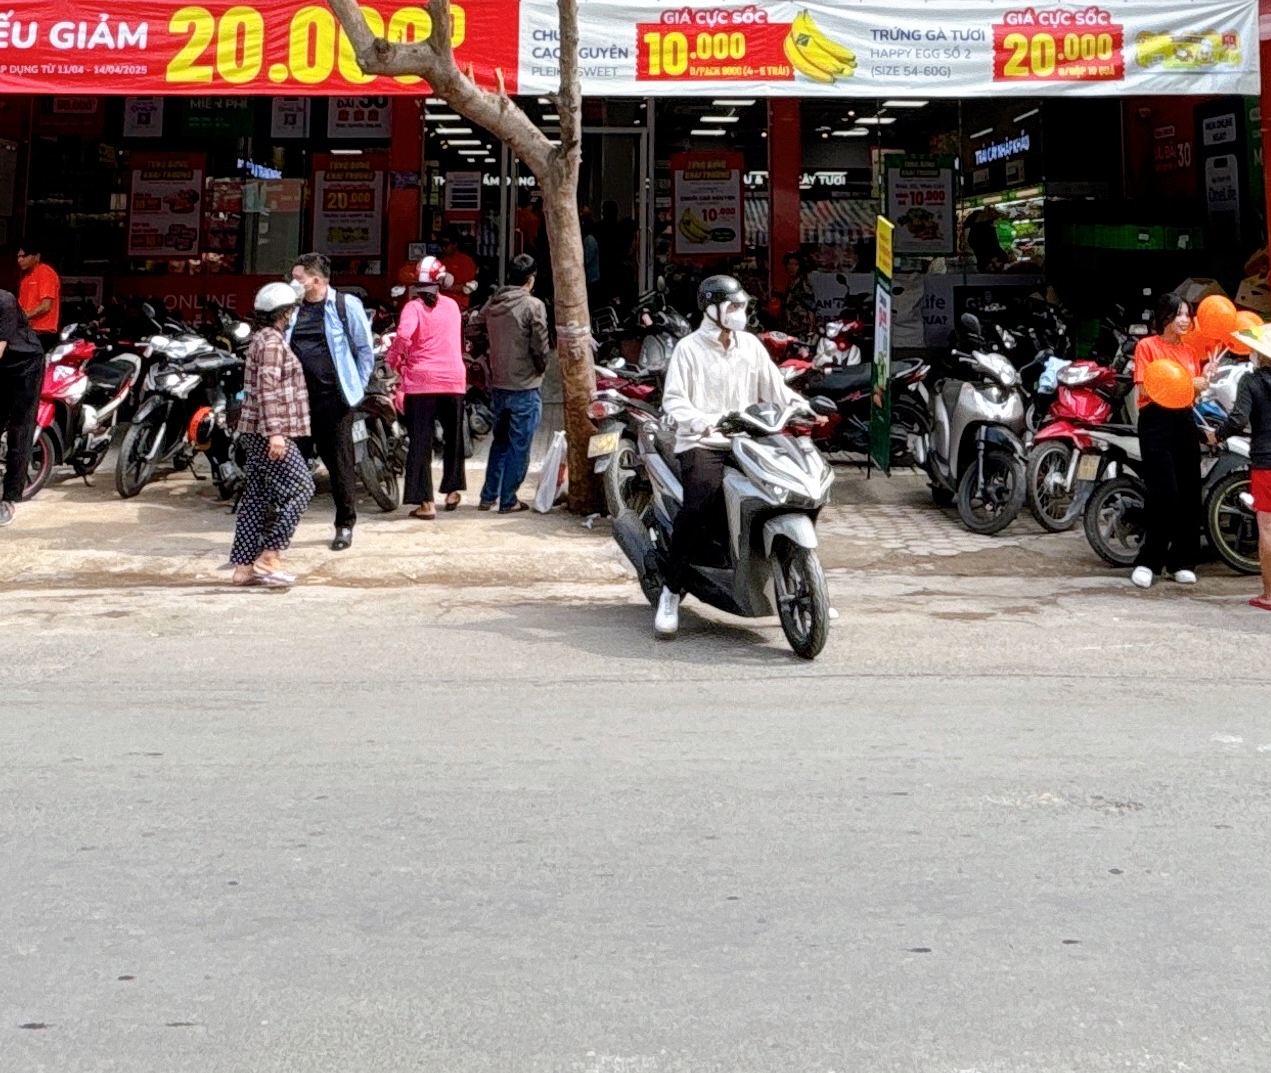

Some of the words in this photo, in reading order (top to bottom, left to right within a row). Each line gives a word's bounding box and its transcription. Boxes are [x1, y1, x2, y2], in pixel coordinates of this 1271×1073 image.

[663, 10, 692, 25] GIÁ
[696, 11, 728, 28] CỰC
[732, 8, 766, 25] SỐC
[1006, 10, 1034, 25] GIÁ
[1039, 10, 1071, 28] CỰC
[1075, 7, 1108, 25] SỐC
[49, 13, 149, 49] GIẢM
[870, 26, 922, 41] TRỨNG
[925, 27, 947, 41] GÀ
[950, 28, 986, 42] TƯƠI
[532, 46, 561, 59] CAO
[578, 44, 629, 59] GUYÊN
[643, 32, 746, 76] 10.000
[870, 48, 912, 59] HAPPY
[915, 48, 941, 59] EGG
[944, 45, 961, 59] SỐ
[964, 48, 971, 59] 2
[1003, 32, 1113, 77] 20.000
[871, 65, 900, 77] (SIZE
[903, 65, 951, 78] 54-60G)
